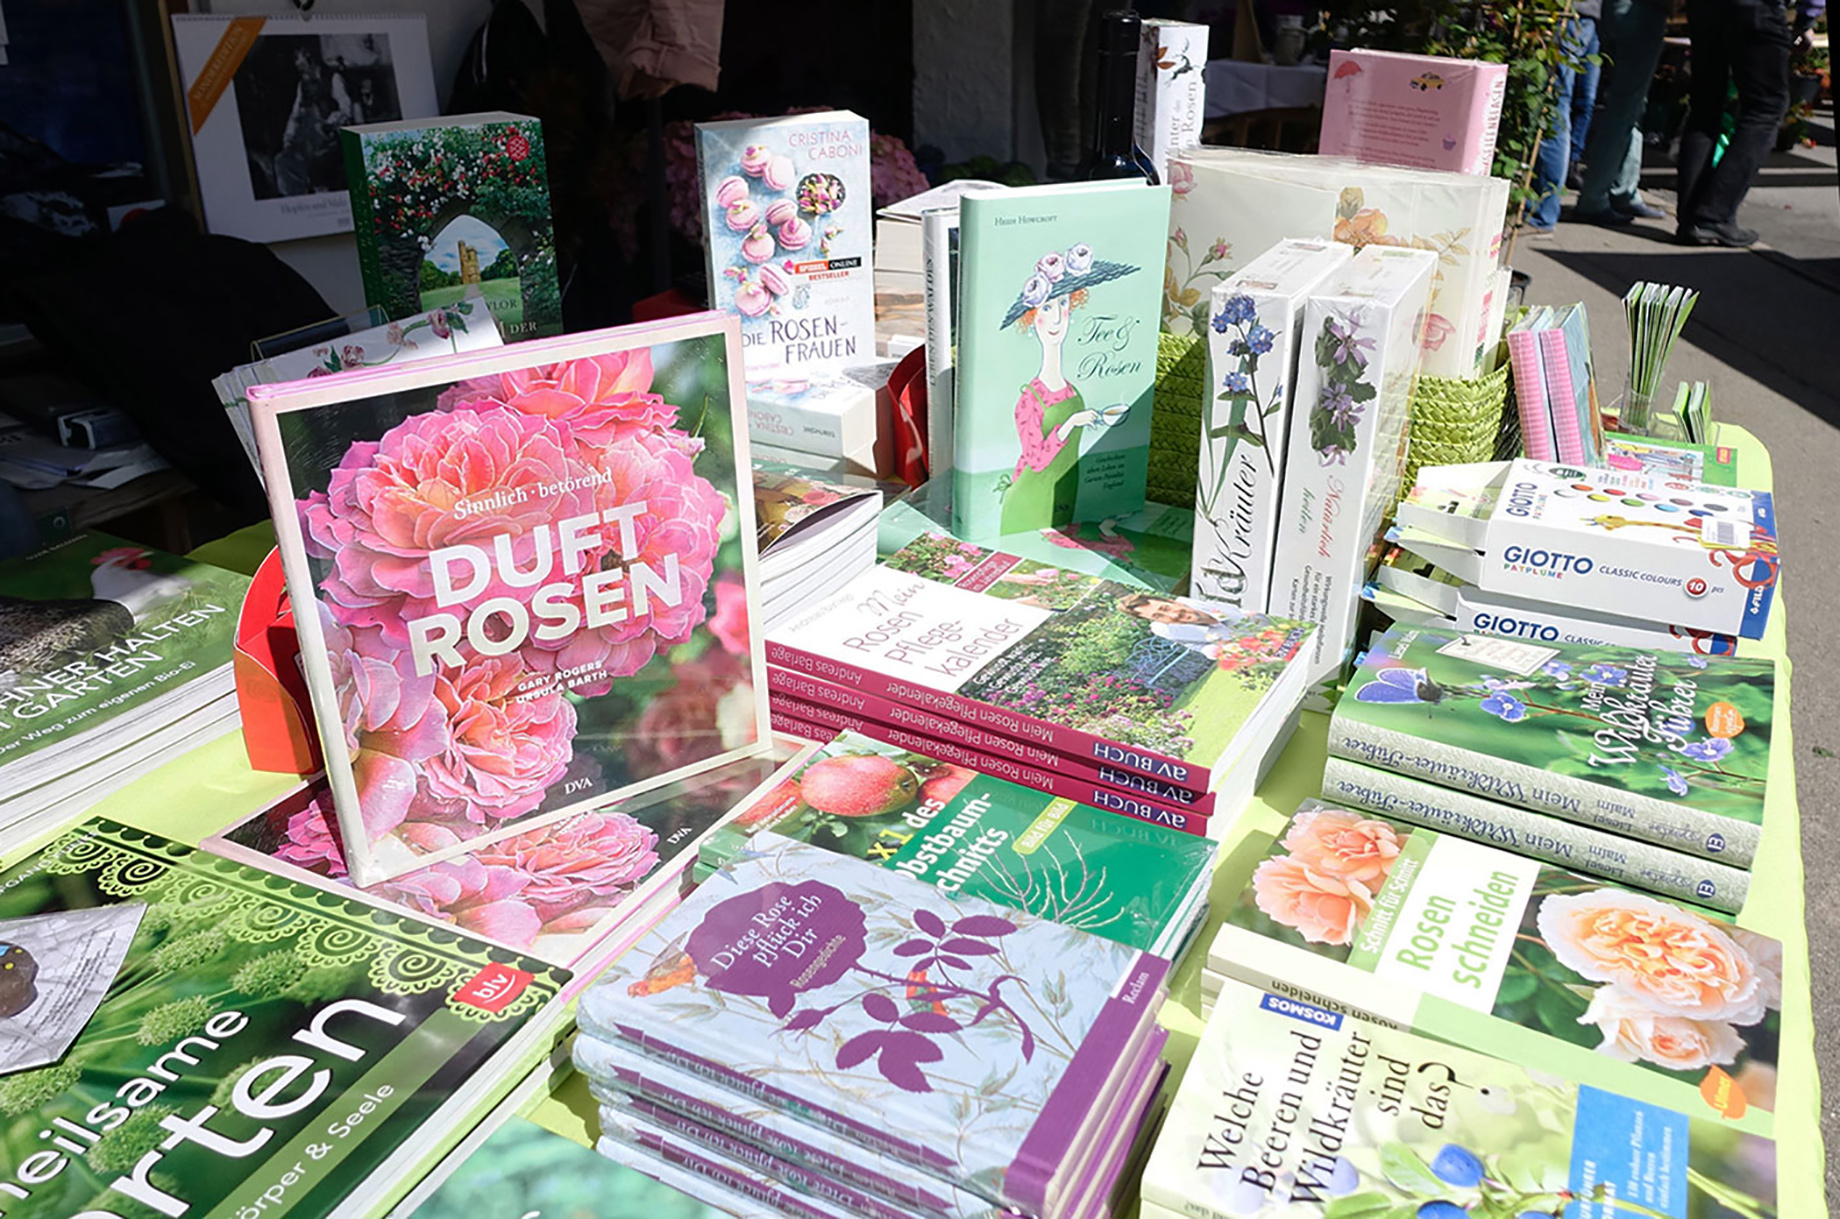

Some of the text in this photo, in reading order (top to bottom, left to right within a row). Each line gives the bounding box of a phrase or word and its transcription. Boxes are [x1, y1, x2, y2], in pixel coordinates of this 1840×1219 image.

[789, 130, 850, 147] CRISTINA
[808, 145, 862, 160] CABONI
[808, 271, 849, 281] BESTSELLER
[830, 258, 859, 270] ONLINE
[743, 315, 847, 347] DIE ROSEN-
[785, 336, 856, 364] FRAUEN
[1077, 313, 1140, 351] Tee &
[1077, 351, 1142, 381] Rosen
[453, 467, 614, 520] Sinnlich betörend
[1299, 486, 1316, 534] heilen
[1507, 482, 1539, 516] GIOTTO
[1207, 453, 1258, 580] Kräuter
[1318, 474, 1345, 559] Natürlich
[429, 502, 648, 608] DUFT
[1503, 545, 1594, 574] GIOTTO
[1503, 562, 1563, 579] PATPLUME
[856, 580, 926, 618] Mein
[1599, 564, 1725, 596] CLASSIC COLOURS 10 pcs
[407, 553, 683, 678] ROSEN
[843, 609, 925, 653] Rosen
[1473, 612, 1560, 642] GIOTTO
[0, 603, 226, 709] HNER HALTEN
[884, 618, 963, 666] Pflege-
[13, 650, 163, 719] GARTEN
[515, 669, 608, 705] URSULA BARTH
[517, 660, 603, 693] GARY ROGERS
[771, 647, 1054, 742] Mein Rosen Pflegekalender Andreas Barlage
[21, 722, 65, 741] Weg
[64, 706, 97, 725] zum
[99, 680, 155, 710] eigenen
[1580, 681, 1606, 712] Mein
[1587, 653, 1659, 768] Wildkräuter
[1641, 678, 1699, 752] Führer
[769, 713, 813, 738] Barlage
[772, 672, 1059, 768] Mein Rosen Pflegekalender Andreas Barlage
[771, 693, 1053, 790] Mein Rosen Pflegekalender Andreas Barlage
[1093, 741, 1148, 775] BUCH
[564, 777, 593, 795] DVA
[1099, 766, 1154, 796] BUCH
[1343, 736, 1580, 813] Mein Wildkräuter-Führer
[901, 798, 946, 829] des
[1093, 791, 1149, 820] BUCH
[1337, 780, 1573, 858] Mein Wildkräuter-Führer
[1592, 813, 1633, 834] Liesel
[1596, 799, 1636, 820] Malm
[667, 825, 692, 845] DVA
[1021, 801, 1070, 849] Bild für Bild
[936, 827, 1009, 891] chnitts
[1584, 858, 1625, 879] Liesel
[1588, 845, 1628, 865] Malm
[1360, 857, 1420, 955] Schnitt für Schnitt
[710, 893, 792, 972] Diese Rose
[752, 893, 821, 968] pflück ich
[783, 926, 819, 961] Dir
[1396, 894, 1456, 971] Rosen
[1451, 869, 1520, 990] schneiden
[472, 972, 509, 1000] blv
[1122, 971, 1150, 1006] Reclam
[1272, 979, 1352, 1018] schneiden
[1267, 996, 1338, 1027] KOSMOS
[1370, 1054, 1411, 1117] sind
[1411, 1061, 1489, 1129] das?
[1714, 1075, 1733, 1111] Ulmer
[68, 999, 407, 1219] rten
[1197, 1072, 1264, 1171] Welche
[1240, 1030, 1322, 1192] Beeren und
[1289, 1031, 1372, 1205] Wildkräuter
[232, 1081, 394, 1219] örper & Seele
